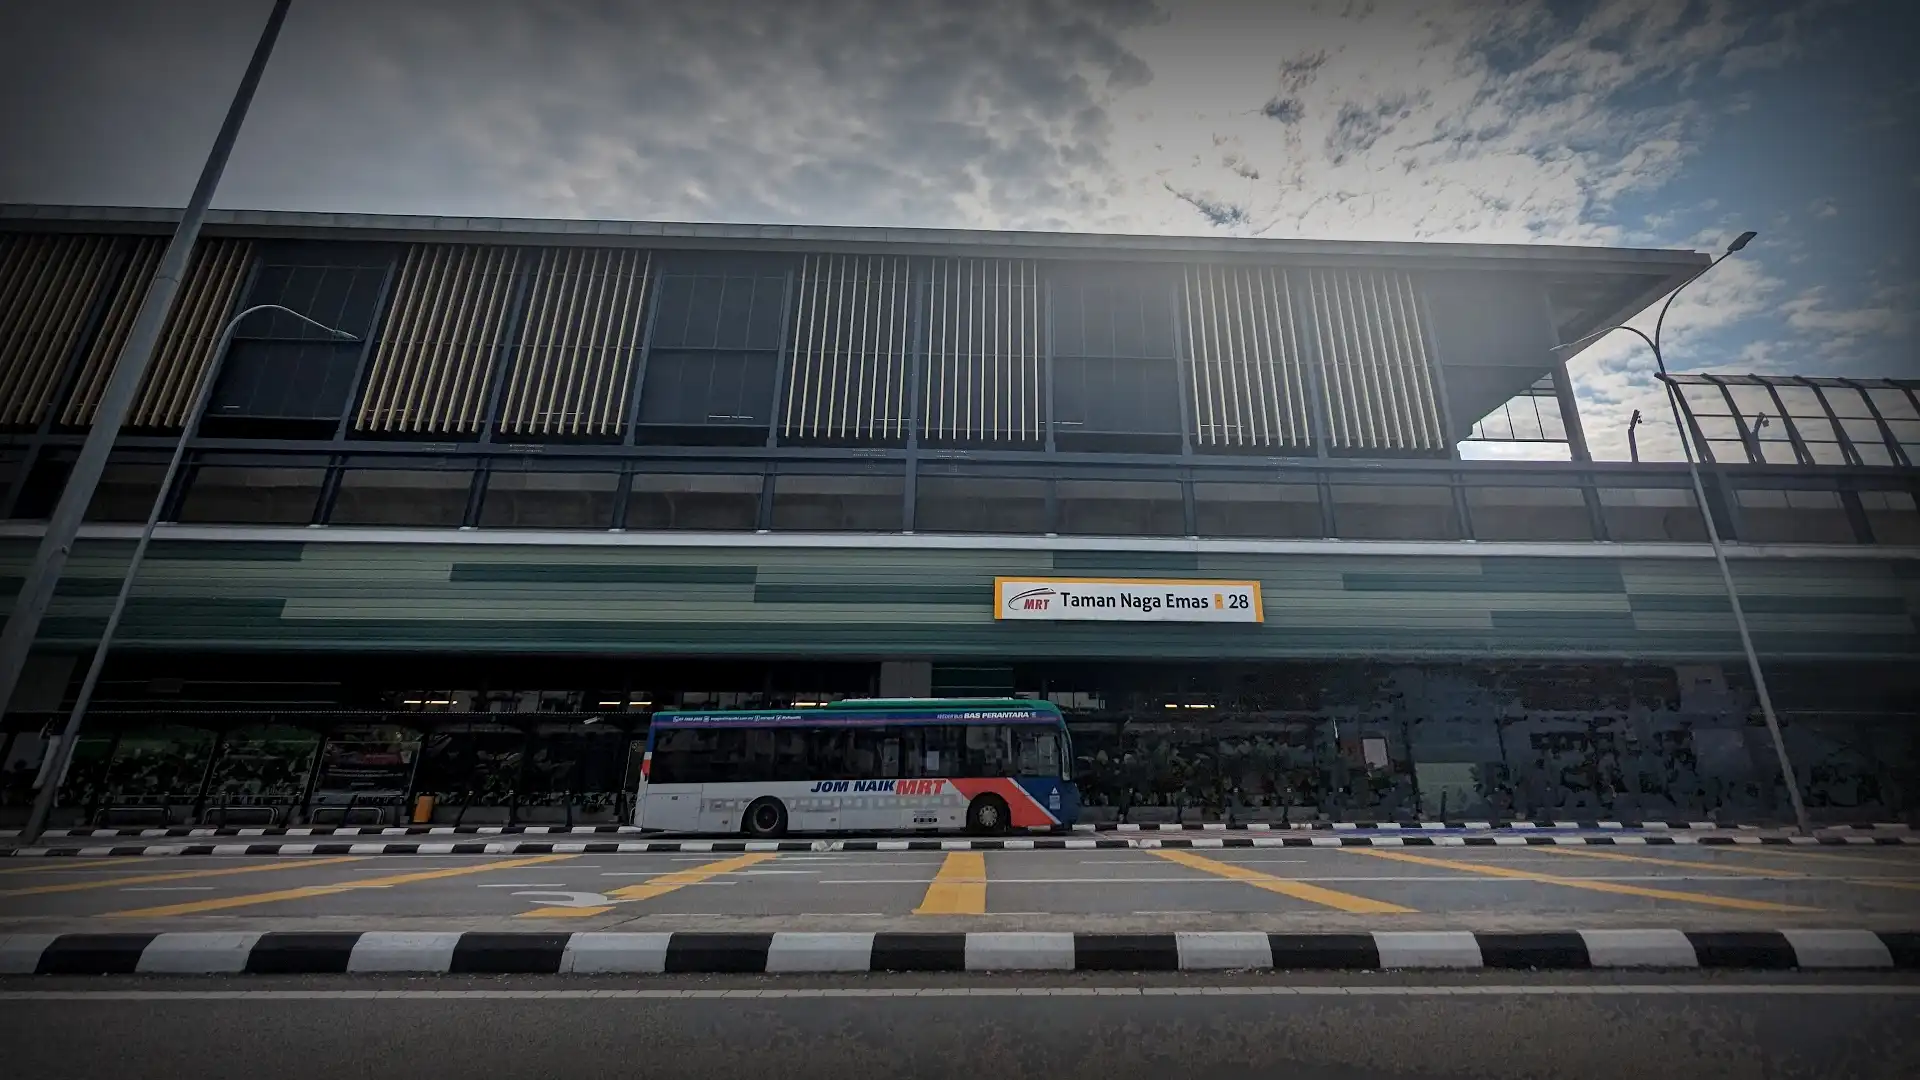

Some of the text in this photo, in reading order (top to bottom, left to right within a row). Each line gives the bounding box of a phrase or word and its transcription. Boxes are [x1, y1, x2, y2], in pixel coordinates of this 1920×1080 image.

[1023, 599, 1050, 610] MRT
[1060, 592, 1249, 612] Taman Naga Emas 28
[982, 711, 1029, 719] PERANTARA
[810, 779, 947, 795] JOM NAIK MRT
